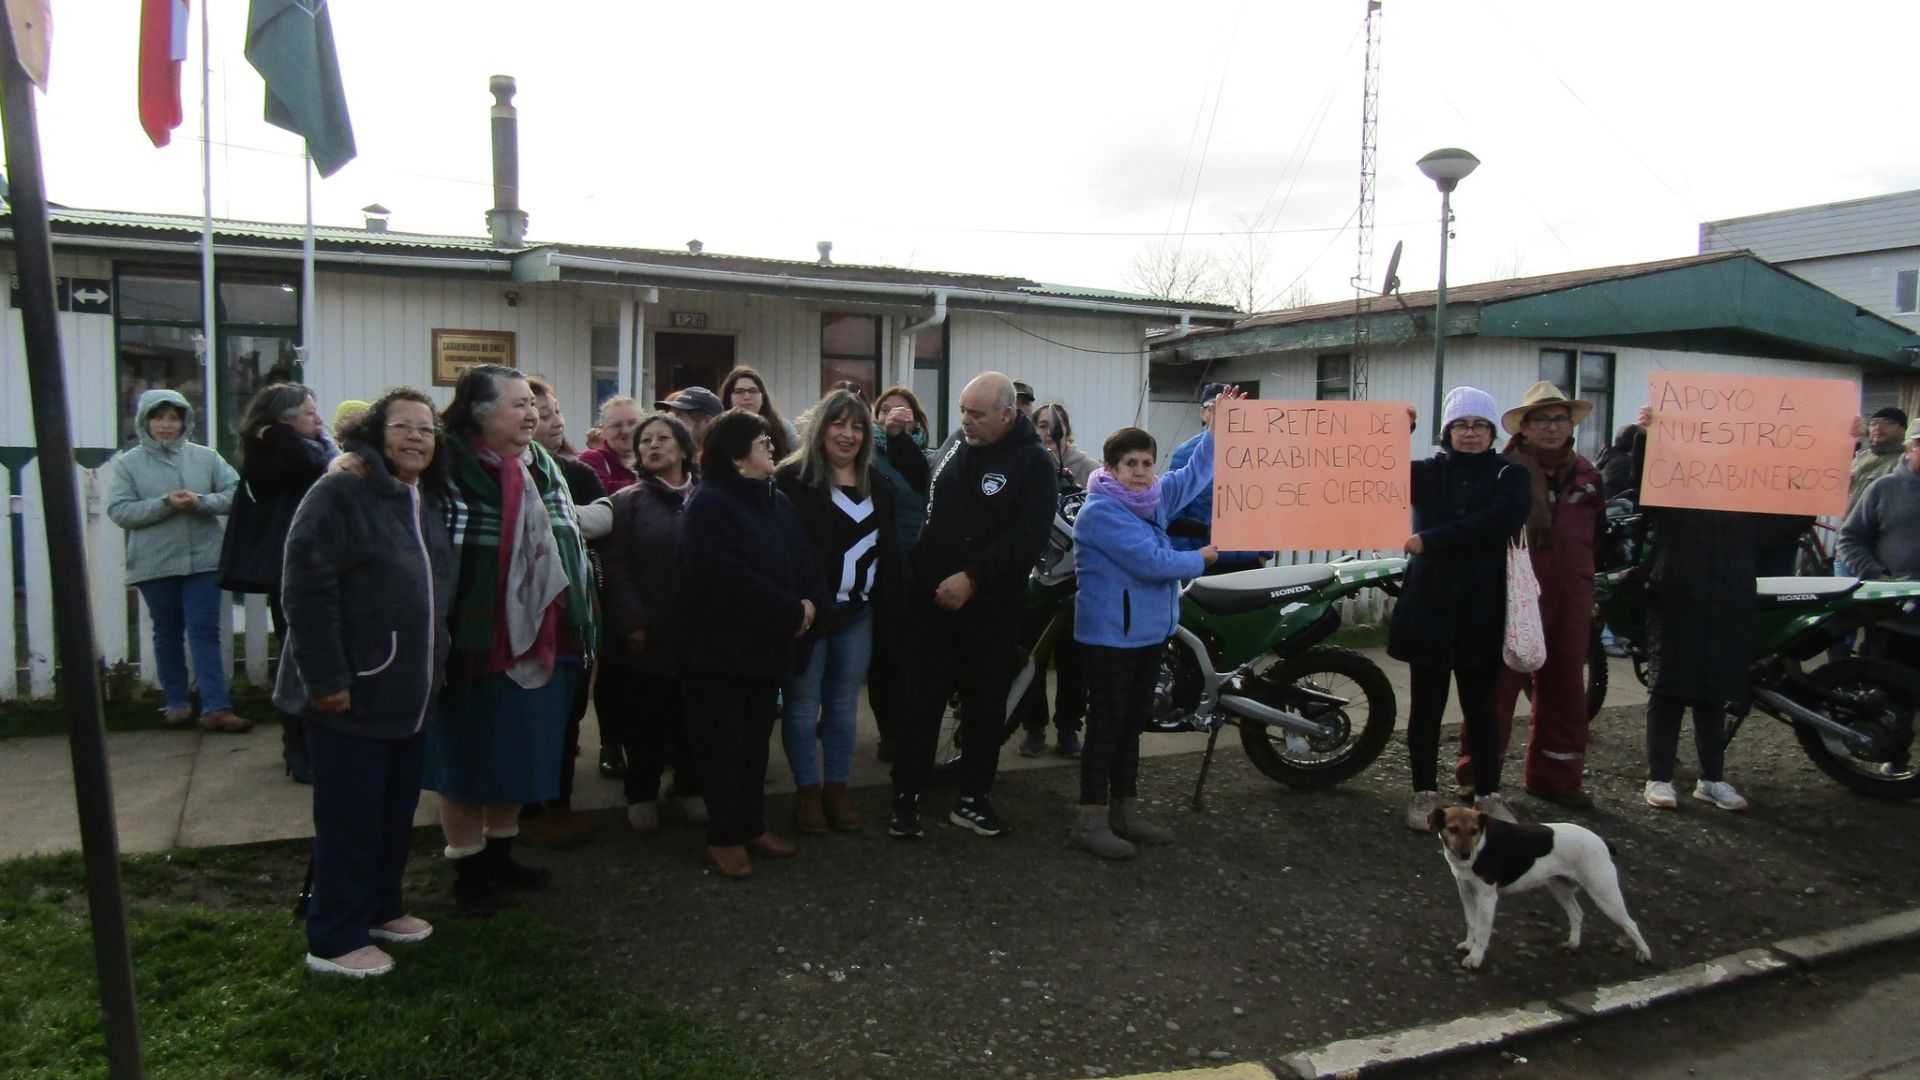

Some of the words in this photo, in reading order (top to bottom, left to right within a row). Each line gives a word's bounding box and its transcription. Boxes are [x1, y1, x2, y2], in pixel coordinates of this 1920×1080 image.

[1777, 393, 1795, 414] A
[1227, 407, 1255, 434] EL
[1264, 407, 1347, 436] RETEN
[1367, 412, 1392, 436] DE
[1656, 420, 1816, 450] NUESTROS
[1225, 444, 1396, 470] CARABINEROS
[1216, 483, 1265, 519] ¡NO
[1275, 482, 1311, 507] SE
[1323, 479, 1408, 510] CIERRA!
[1269, 584, 1313, 598] HONDA
[1776, 593, 1819, 602] HONDA
